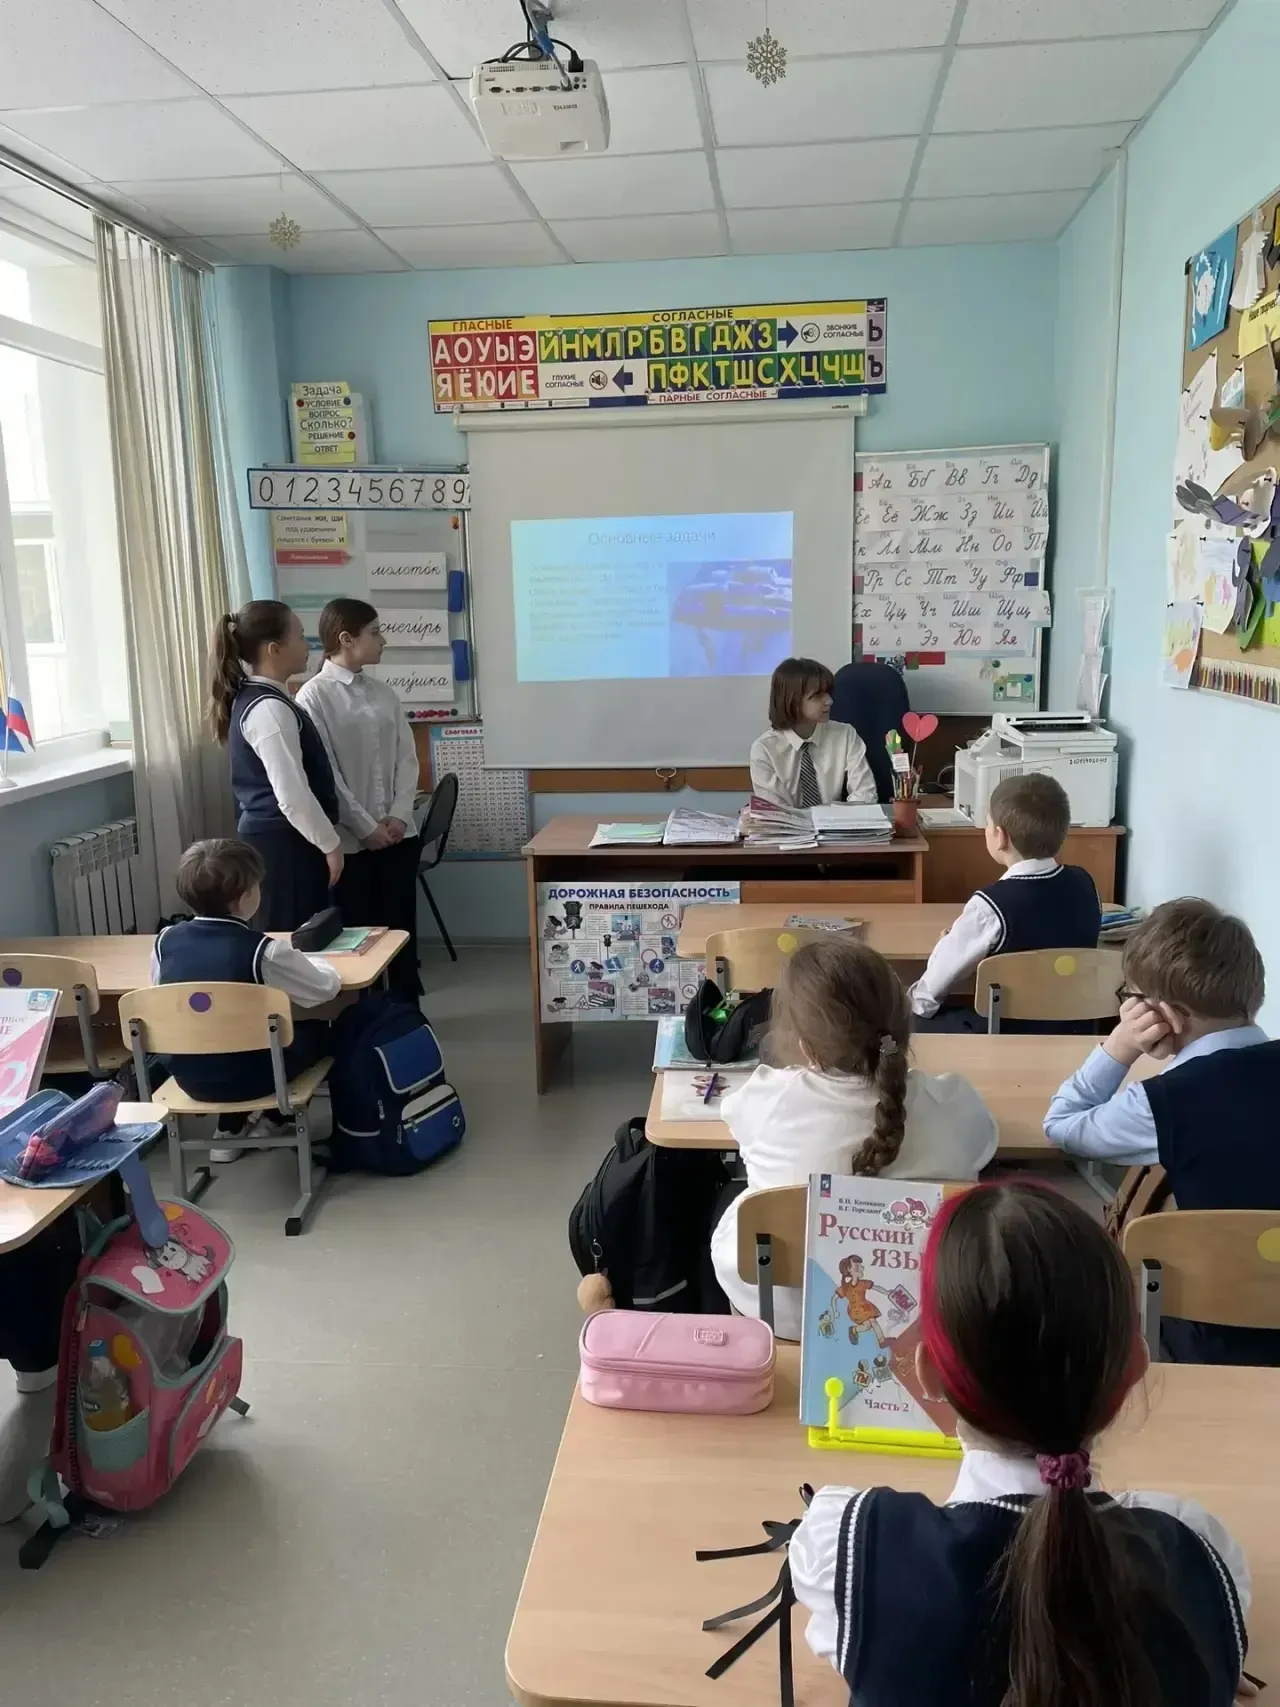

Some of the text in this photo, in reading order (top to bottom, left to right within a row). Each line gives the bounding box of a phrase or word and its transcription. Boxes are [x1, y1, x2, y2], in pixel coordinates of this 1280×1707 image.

[652, 308, 733, 323] СОГЛАСНЫЕ
[452, 319, 513, 332] ГЛАСНЫЕ
[823, 329, 864, 339] СОГЛАСНЫЕ
[545, 380, 584, 389] СОГЛАСНЫЕ
[302, 385, 342, 398] Задача
[659, 390, 768, 403] ПАРНЫЕ СОГЛАСНЫЕ
[306, 399, 341, 408] УСЛОВИЕ
[309, 410, 340, 418] ВОПРОС
[308, 431, 344, 440] РЕШЕНИЕ
[314, 445, 338, 453] ОТВЕТ
[868, 472, 892, 489] Аа
[908, 469, 936, 488] Бб
[945, 468, 968, 486] Вв
[1014, 464, 1038, 489] Дд
[588, 531, 716, 546] Основные задачи
[993, 534, 1012, 552] Оо
[548, 887, 730, 900] ДОРОЖНАЯ БЕЗОПАСНОСТЬ
[589, 903, 669, 911] ПРАВИЛА ПЕШЕХОДА
[818, 1212, 914, 1245] Русский
[864, 1399, 909, 1412] Часть 2
